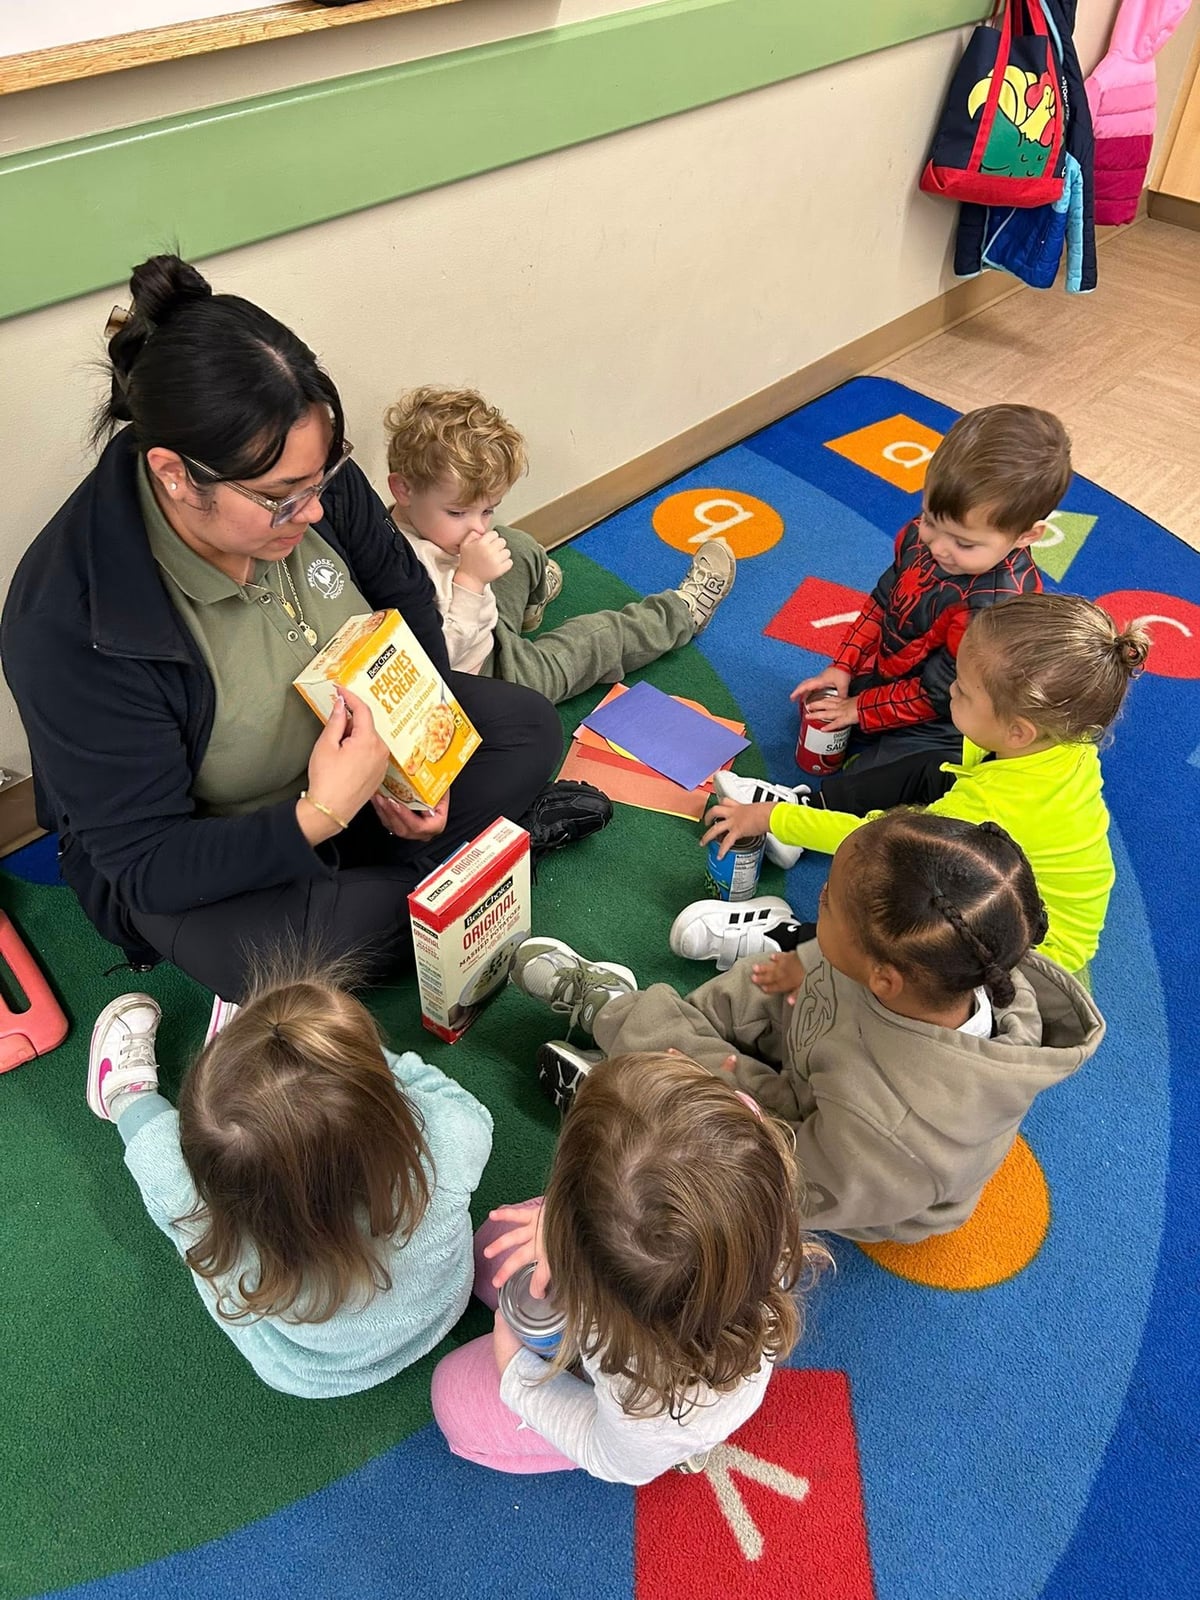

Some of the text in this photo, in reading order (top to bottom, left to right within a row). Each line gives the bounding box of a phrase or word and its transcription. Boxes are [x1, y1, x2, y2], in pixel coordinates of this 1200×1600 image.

[369, 647, 396, 676] Best Choice
[369, 649, 412, 701] PEACHES
[381, 698, 394, 714] &
[389, 664, 421, 704] CREAM
[390, 709, 414, 739] instant
[414, 677, 438, 711] oatmeal
[450, 847, 486, 875] ORIGINAL
[462, 890, 518, 950] ORIGINAL
[466, 904, 484, 927] Best
[484, 880, 513, 907] Choice
[459, 937, 489, 968] MASHED
[490, 903, 521, 940] POTATOES
[476, 916, 507, 945] INSTANT
